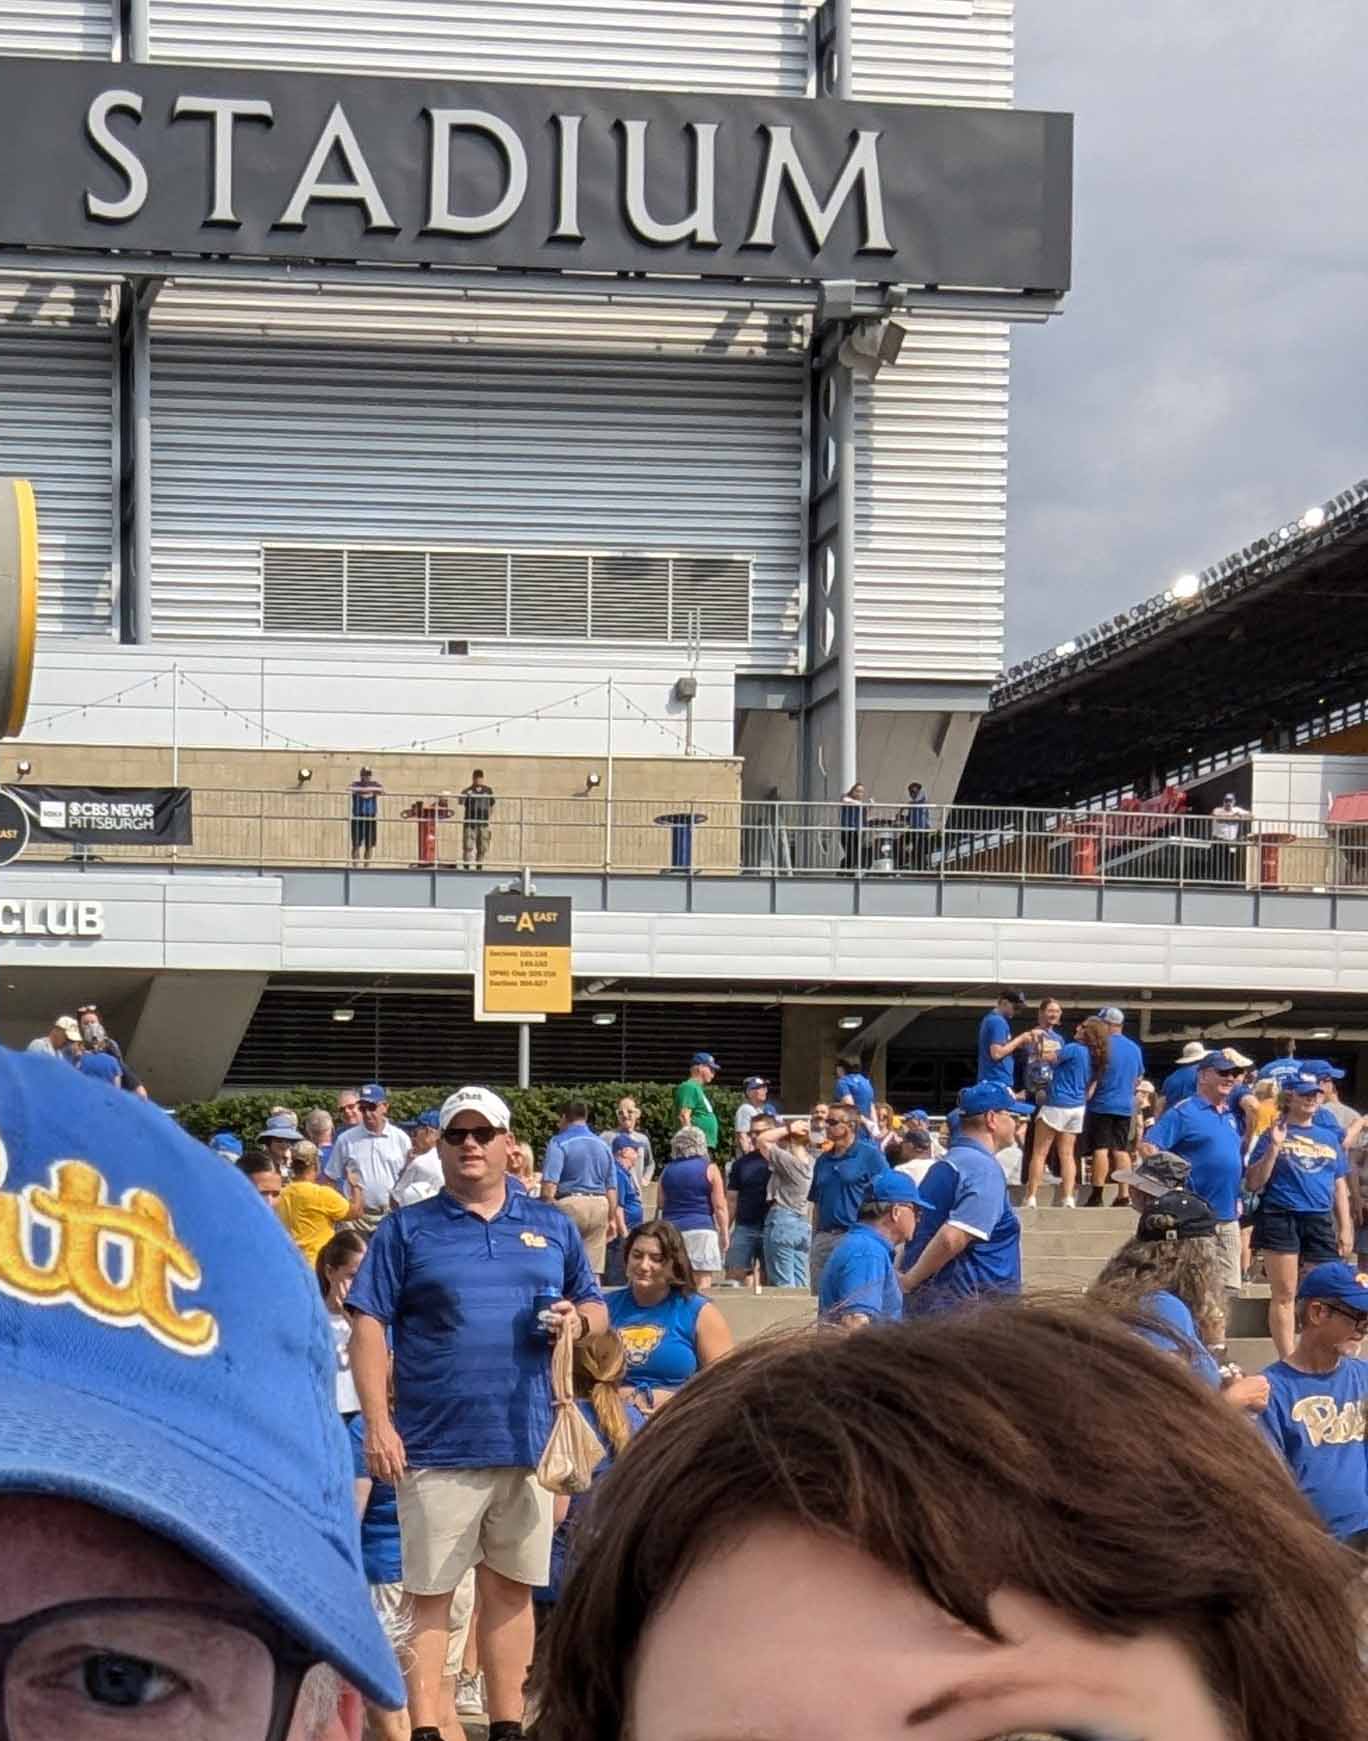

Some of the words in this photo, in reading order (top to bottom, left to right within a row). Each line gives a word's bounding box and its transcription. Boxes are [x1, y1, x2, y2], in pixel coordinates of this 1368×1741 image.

[83, 88, 894, 258] STADIUM
[81, 803, 108, 816] CBS
[111, 803, 155, 816] NEWS
[69, 816, 155, 830] PITTSBURGH
[516, 911, 535, 932] A
[533, 911, 559, 922] EAST
